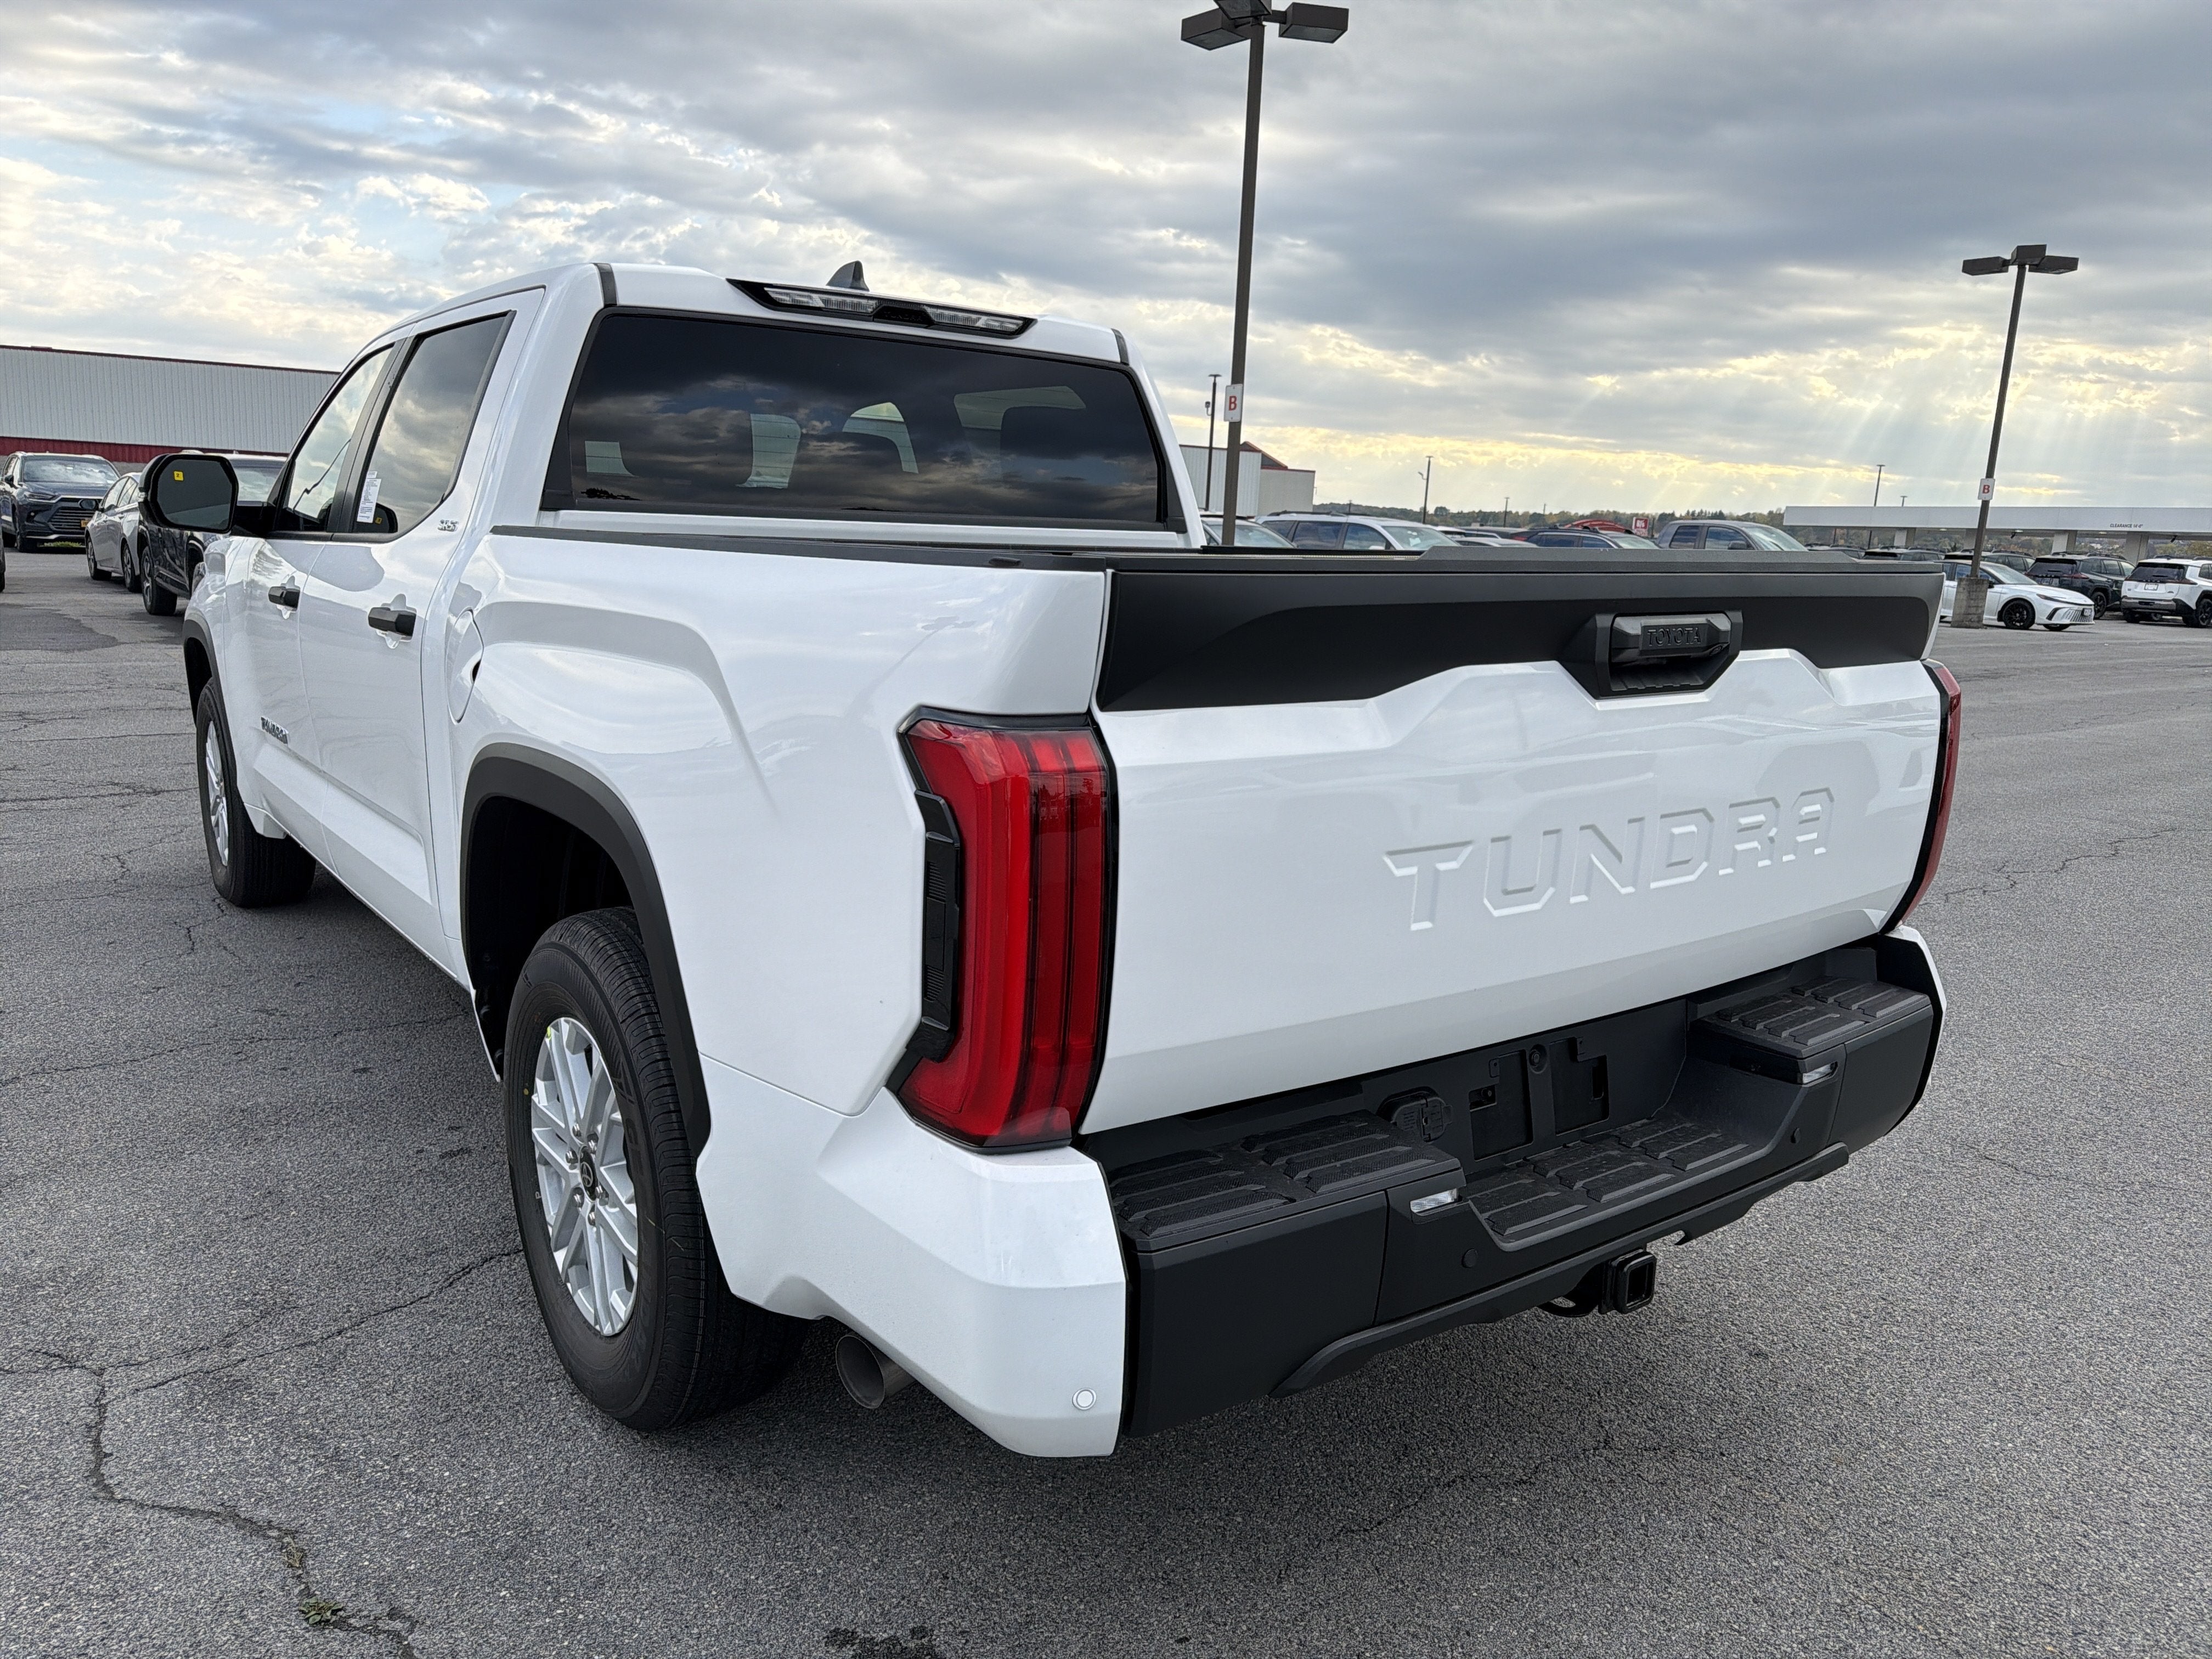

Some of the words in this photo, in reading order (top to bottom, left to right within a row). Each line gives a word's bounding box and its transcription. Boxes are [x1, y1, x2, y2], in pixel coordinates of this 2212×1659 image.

[1228, 396, 1237, 411] B
[1982, 484, 1990, 494] B
[1647, 627, 1701, 647] TOYOTA
[1383, 787, 1834, 930] TUNDRA
